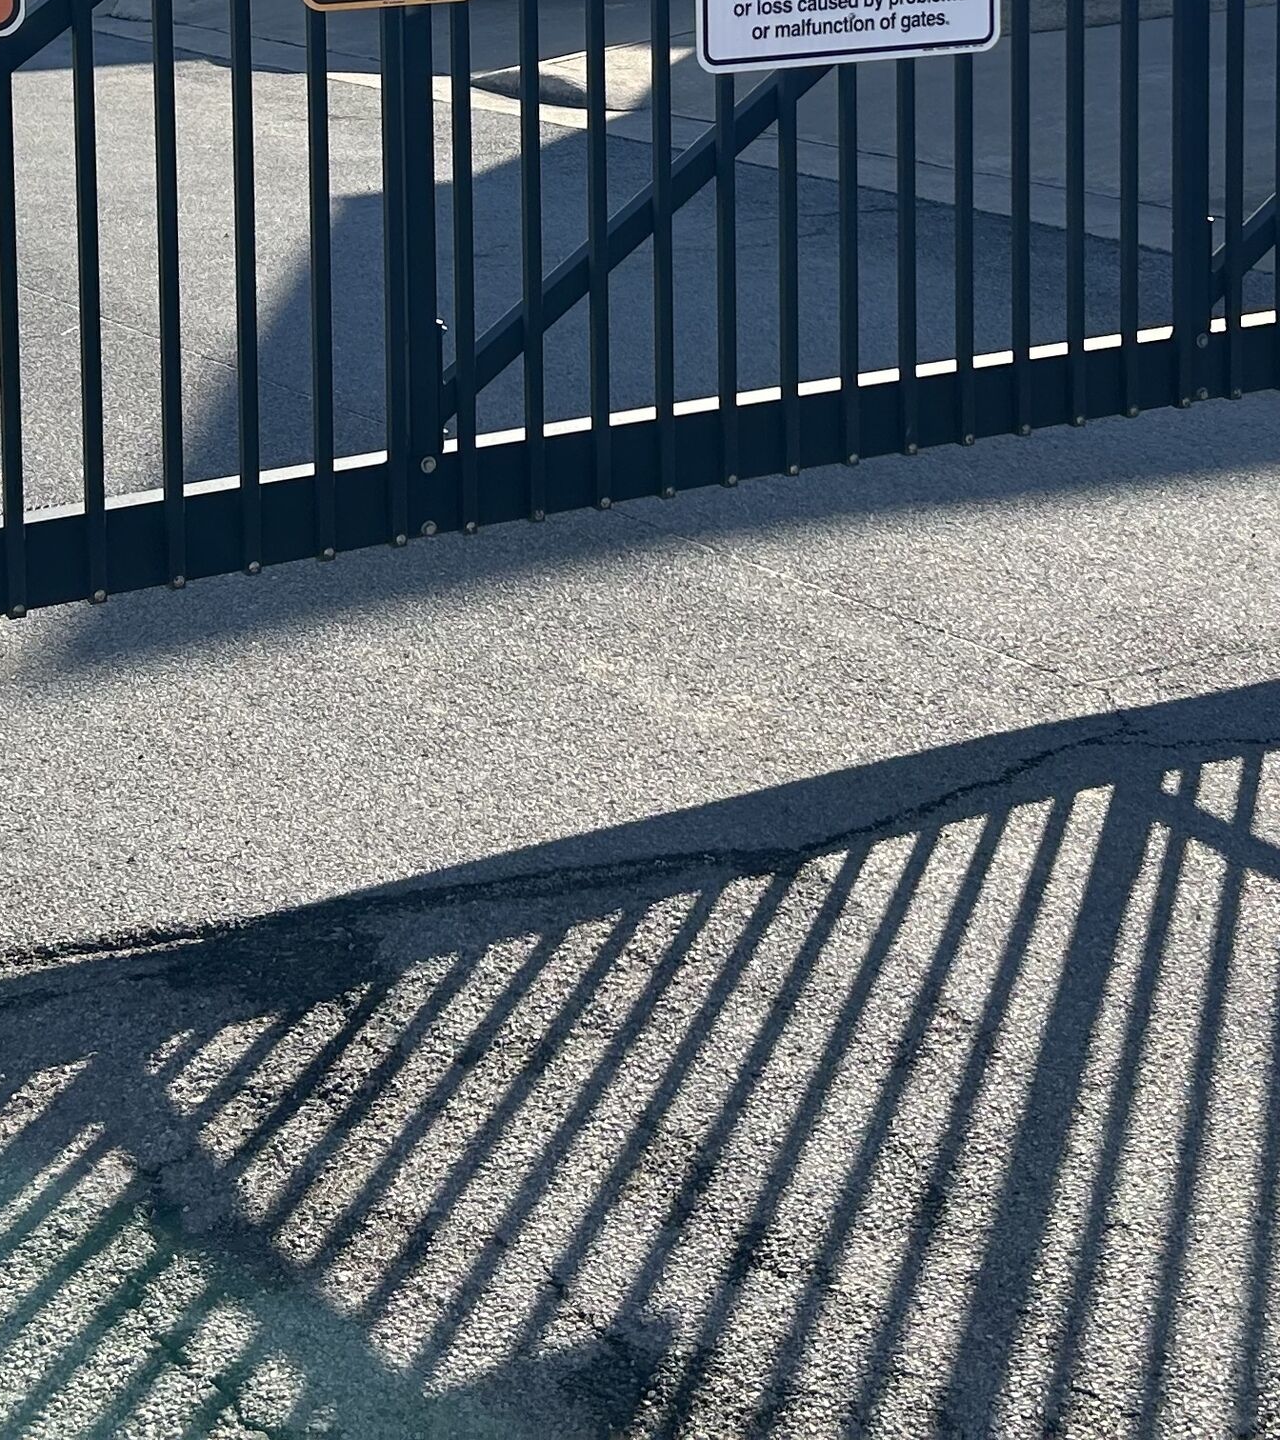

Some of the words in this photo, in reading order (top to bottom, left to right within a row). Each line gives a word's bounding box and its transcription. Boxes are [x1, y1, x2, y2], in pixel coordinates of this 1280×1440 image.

[733, 2, 753, 18] or
[752, 25, 771, 40] or
[775, 16, 875, 38] malfunction
[879, 11, 897, 30] of
[900, 12, 950, 33] gates.
